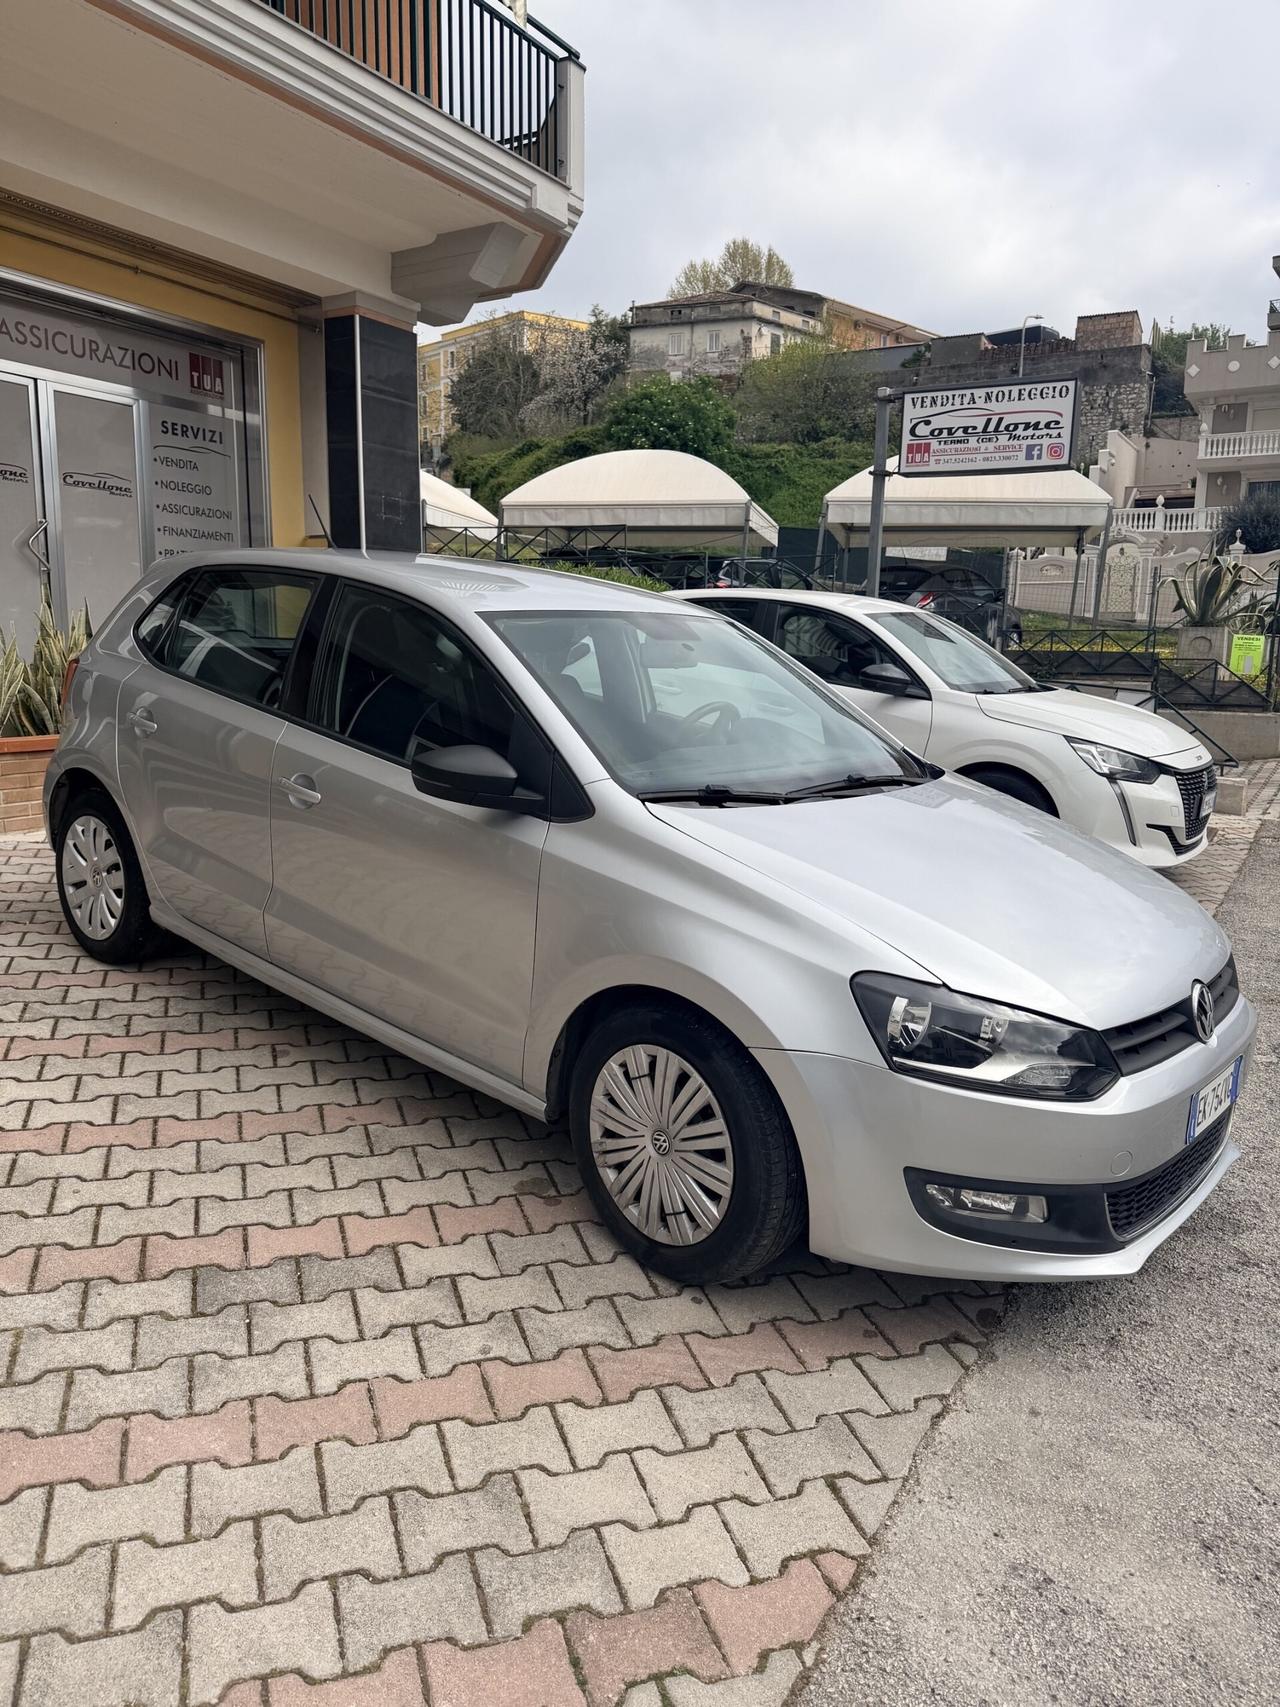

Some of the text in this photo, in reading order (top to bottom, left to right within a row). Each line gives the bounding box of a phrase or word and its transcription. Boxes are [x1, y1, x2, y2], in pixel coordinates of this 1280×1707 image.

[0, 317, 179, 381] ASSICURAZIONI
[191, 371, 223, 393] TUA
[161, 420, 223, 445] SERVIZI
[909, 416, 1065, 439] Covellone
[1007, 431, 1063, 442] Motors
[976, 436, 999, 445] (CE)
[993, 444, 1024, 452] SERVICE
[158, 456, 199, 472] VENDITA
[907, 452, 929, 463] TUA
[62, 474, 133, 493] Covellone
[160, 480, 213, 496] NOLEGGIO
[162, 503, 233, 521] ASSICURAZIONI
[163, 525, 234, 543] FINANZIAMENTI
